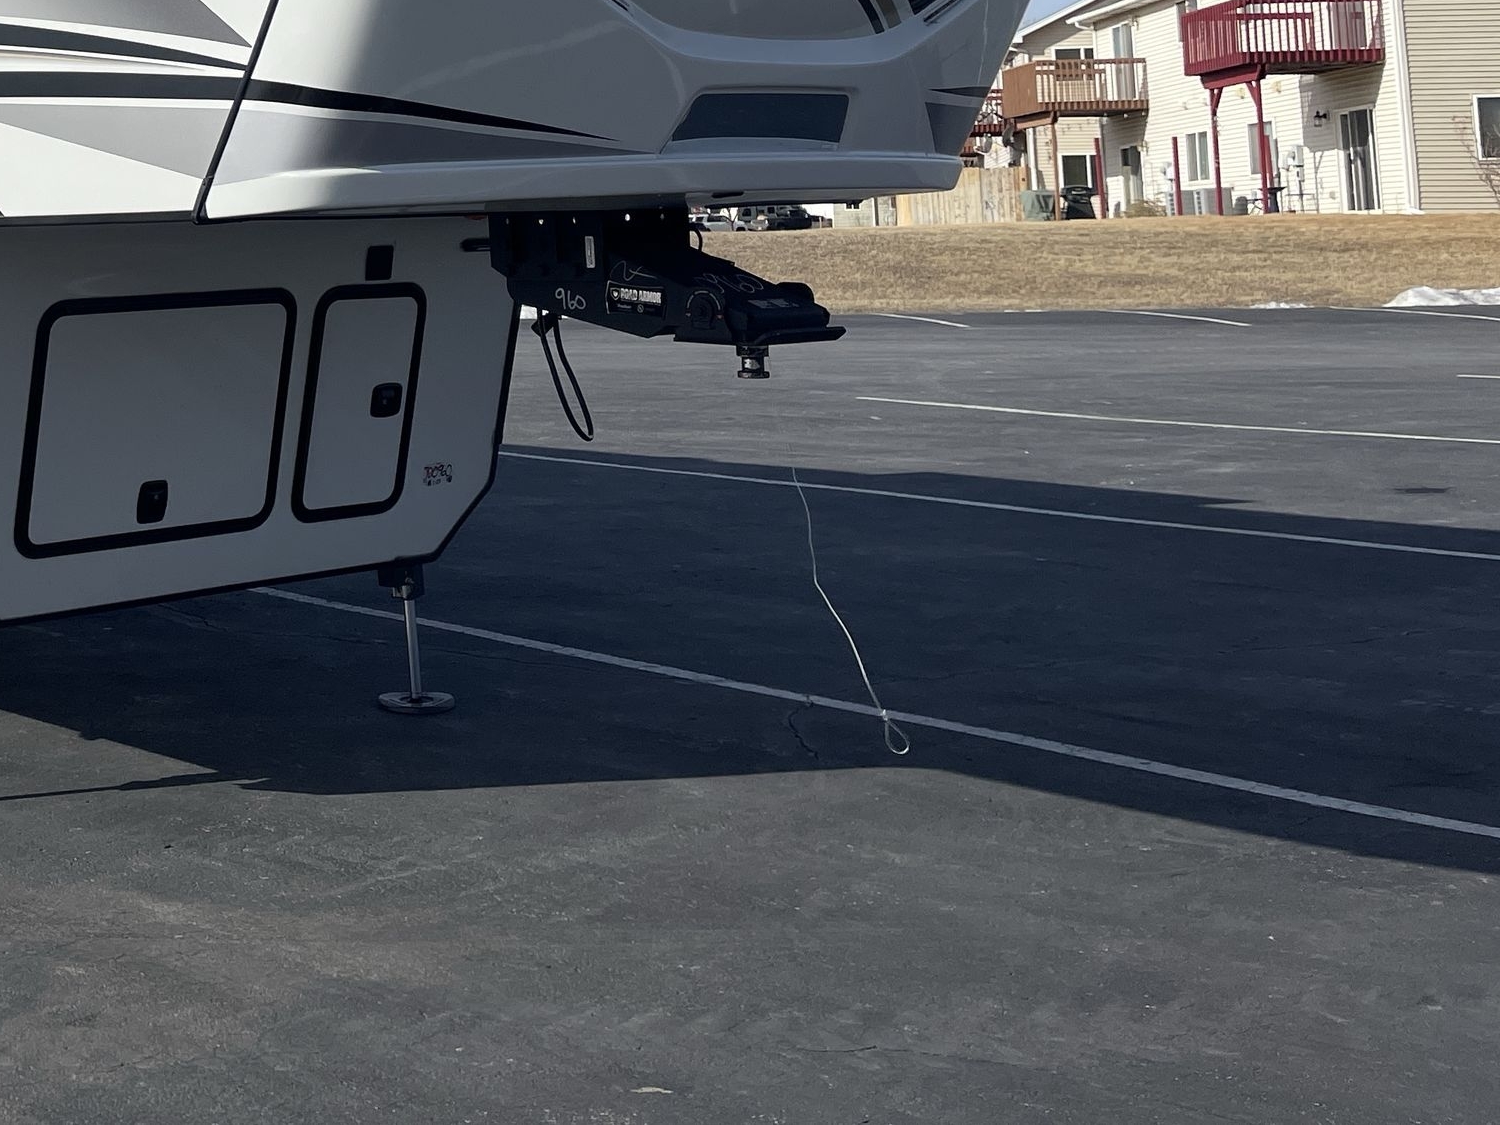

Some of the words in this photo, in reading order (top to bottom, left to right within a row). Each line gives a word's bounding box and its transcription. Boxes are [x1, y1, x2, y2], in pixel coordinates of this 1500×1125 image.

[555, 287, 587, 310] 960
[620, 287, 638, 301] ROAD
[638, 289, 662, 304] ARMOR
